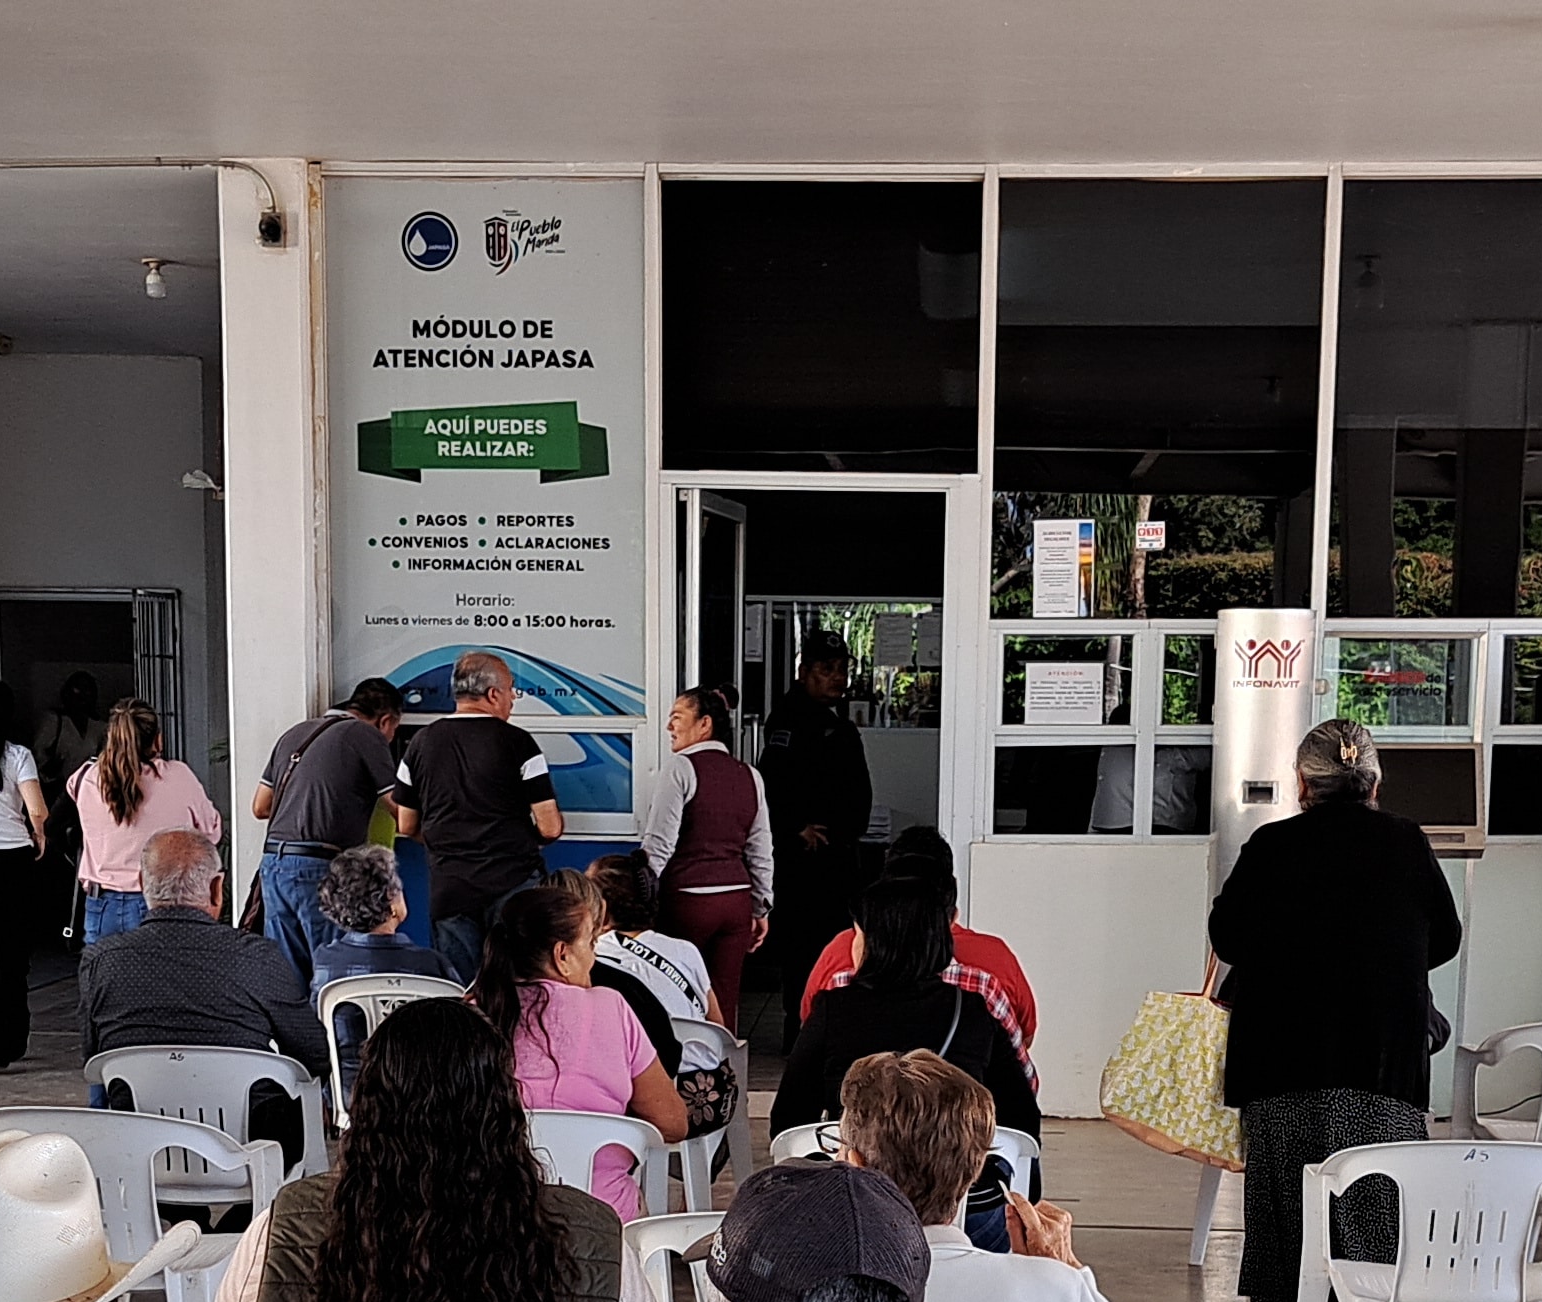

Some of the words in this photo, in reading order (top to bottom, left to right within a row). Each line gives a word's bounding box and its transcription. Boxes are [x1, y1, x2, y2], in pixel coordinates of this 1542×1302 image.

[518, 216, 562, 241] Pueblo
[523, 233, 560, 256] Manda
[412, 314, 516, 339] MÓDULO
[522, 320, 554, 339] DE
[372, 343, 494, 369] ATENCIÓN
[500, 350, 595, 369] JAPASA
[424, 417, 471, 436] AQUÍ
[475, 419, 547, 436] PUEDES
[438, 441, 535, 458] REALIZAR:
[416, 514, 468, 528] PAGOS
[496, 514, 575, 529] REPORTES
[381, 536, 469, 551] CONVENIOS
[494, 536, 611, 551] ACLARACIONES
[408, 555, 512, 572] INFORMACIÓN
[516, 558, 585, 572] GENERAL
[456, 594, 515, 607] Horario:
[365, 615, 399, 625] Lunes
[401, 617, 409, 625] a
[412, 615, 453, 626] viernes
[455, 616, 470, 626] de
[474, 615, 508, 627] 8:00
[512, 618, 521, 627] a
[525, 615, 566, 628] 15:00
[570, 616, 615, 628] horas.
[1232, 680, 1300, 689] INFONAVIT
[621, 936, 651, 960] LOLA
